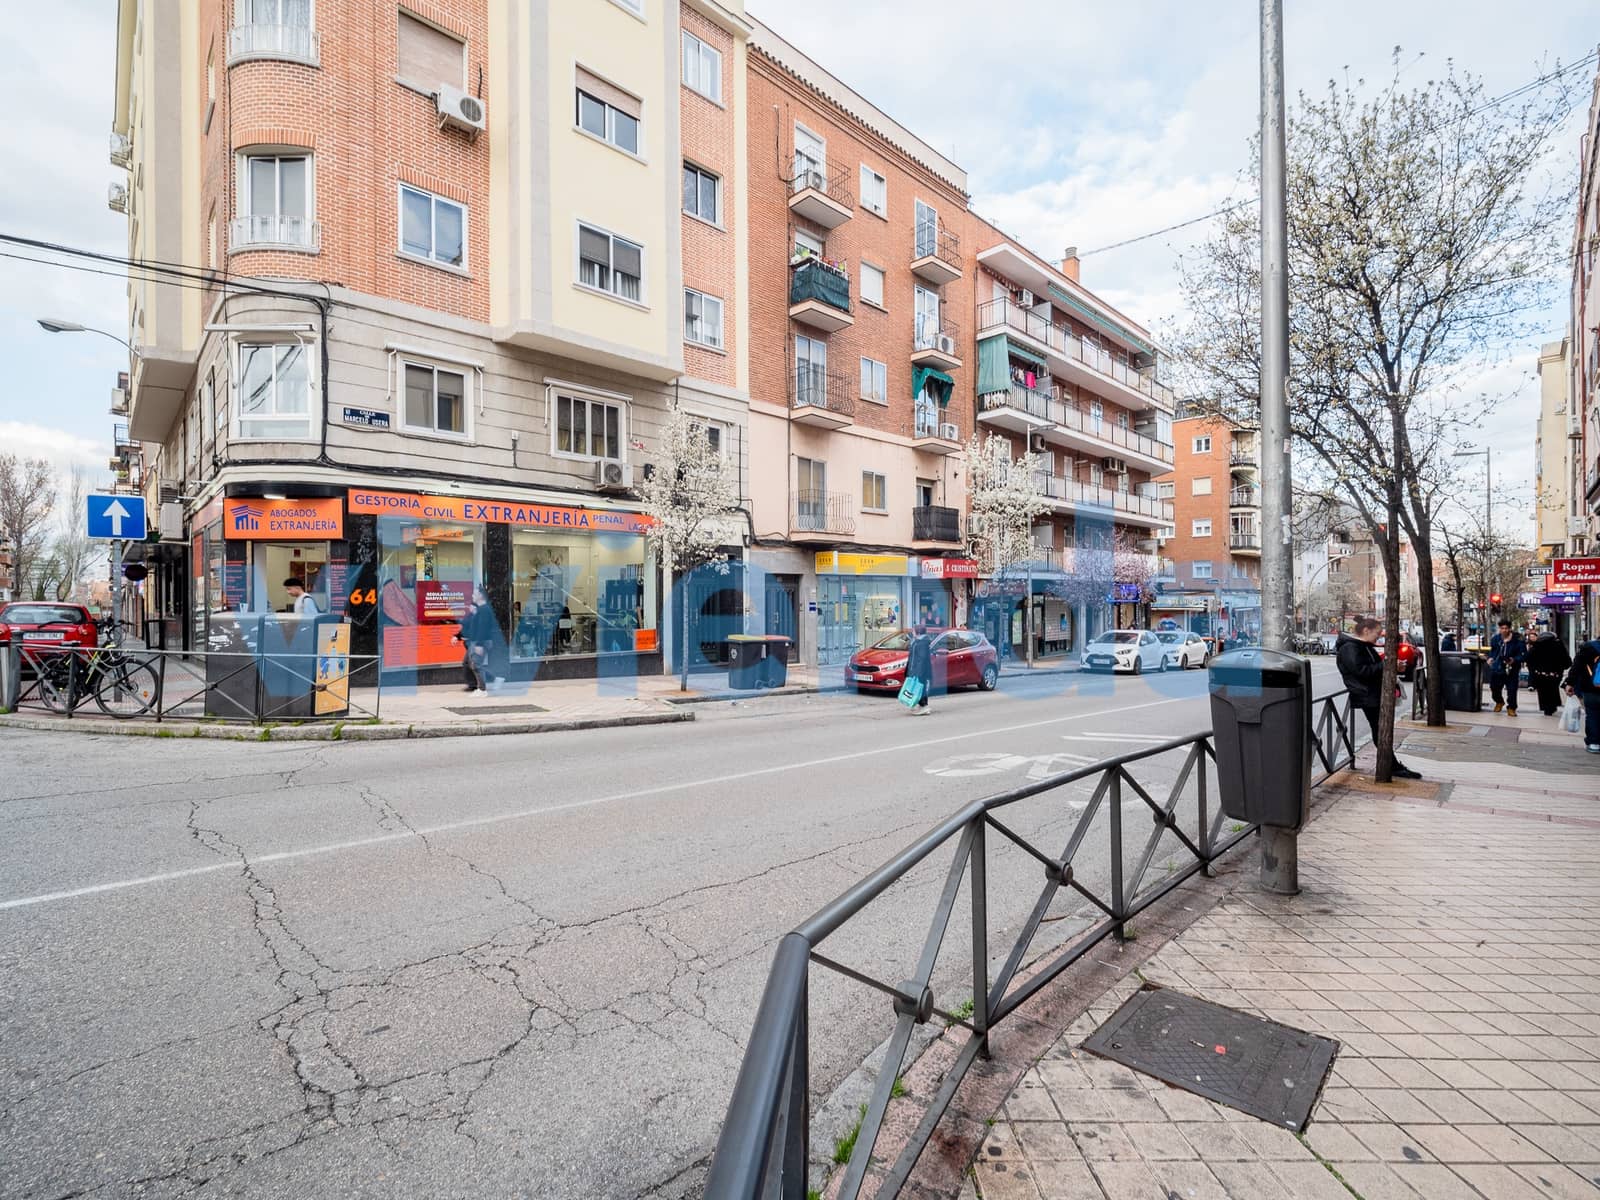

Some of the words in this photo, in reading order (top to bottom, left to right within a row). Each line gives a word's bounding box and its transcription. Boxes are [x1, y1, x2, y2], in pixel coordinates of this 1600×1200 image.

[345, 415, 369, 424] MARCELO
[372, 419, 389, 427] USERA
[270, 508, 317, 517] ABOGADOS
[355, 494, 420, 509] GESTORÍA
[423, 506, 456, 518] CIVIL
[464, 504, 589, 526] EXTRANJERÍA
[593, 514, 624, 525] PENAL
[270, 519, 337, 531] EXTRANJERÍA
[1562, 562, 1596, 572] Ropas
[1557, 573, 1600, 581] Fashion
[350, 588, 377, 605] 64
